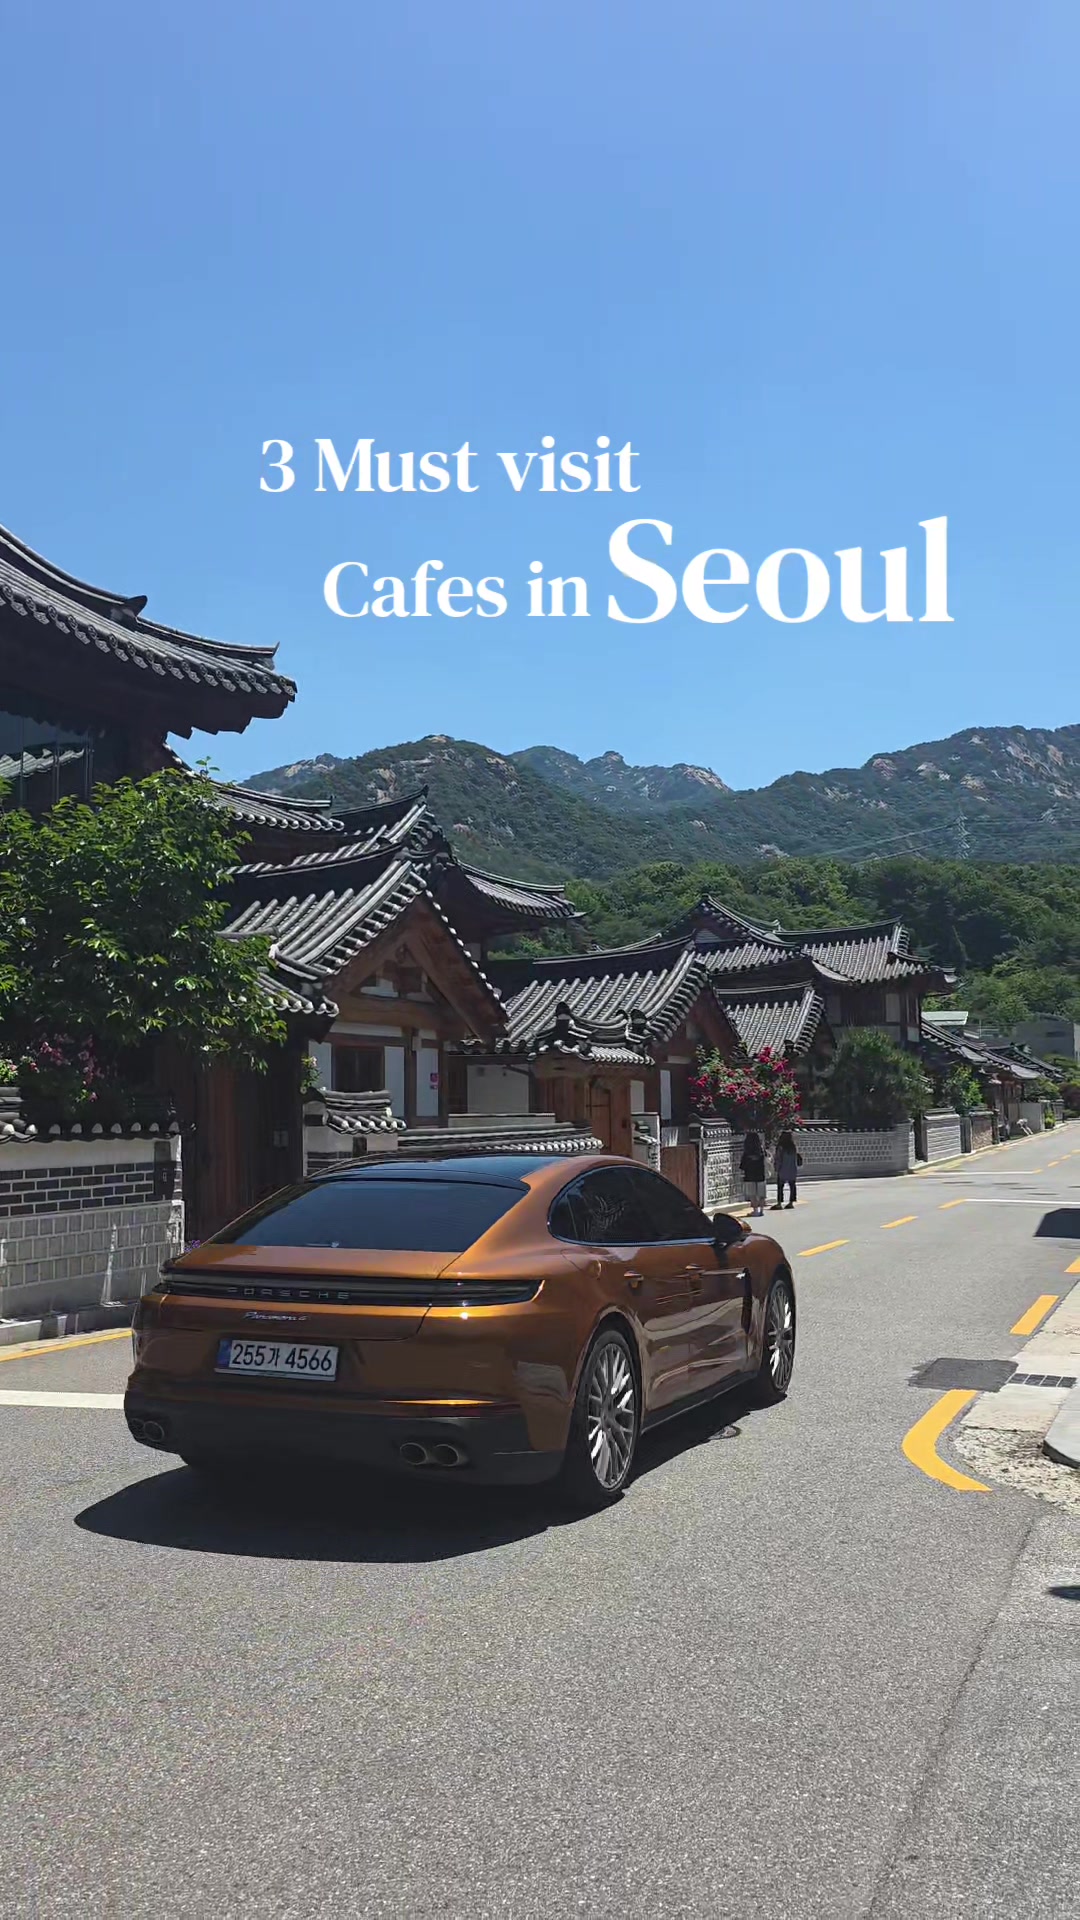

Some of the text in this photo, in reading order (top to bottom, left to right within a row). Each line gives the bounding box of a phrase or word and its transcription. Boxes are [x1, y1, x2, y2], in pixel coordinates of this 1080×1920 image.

[227, 1286, 350, 1300] PORSCHE
[231, 1343, 332, 1371] 255가 4566
